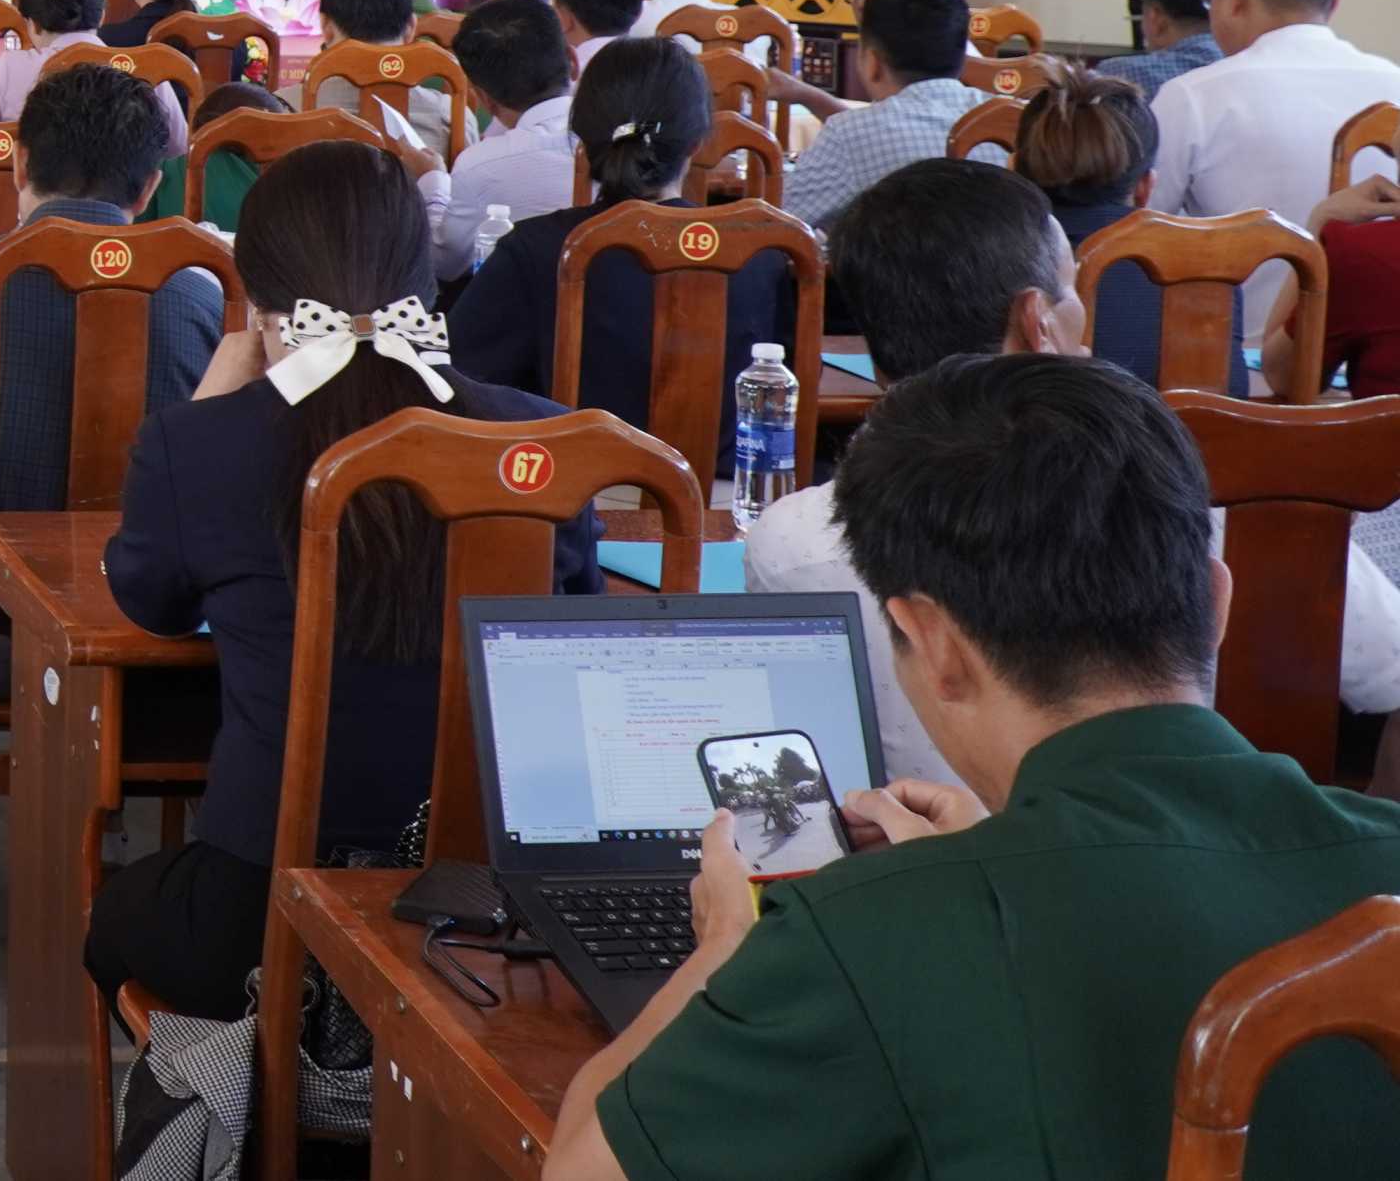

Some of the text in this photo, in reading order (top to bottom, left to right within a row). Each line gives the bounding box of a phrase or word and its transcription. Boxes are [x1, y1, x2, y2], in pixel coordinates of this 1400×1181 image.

[684, 233, 713, 250] 19
[96, 250, 127, 268] 120
[513, 451, 544, 484] 67
